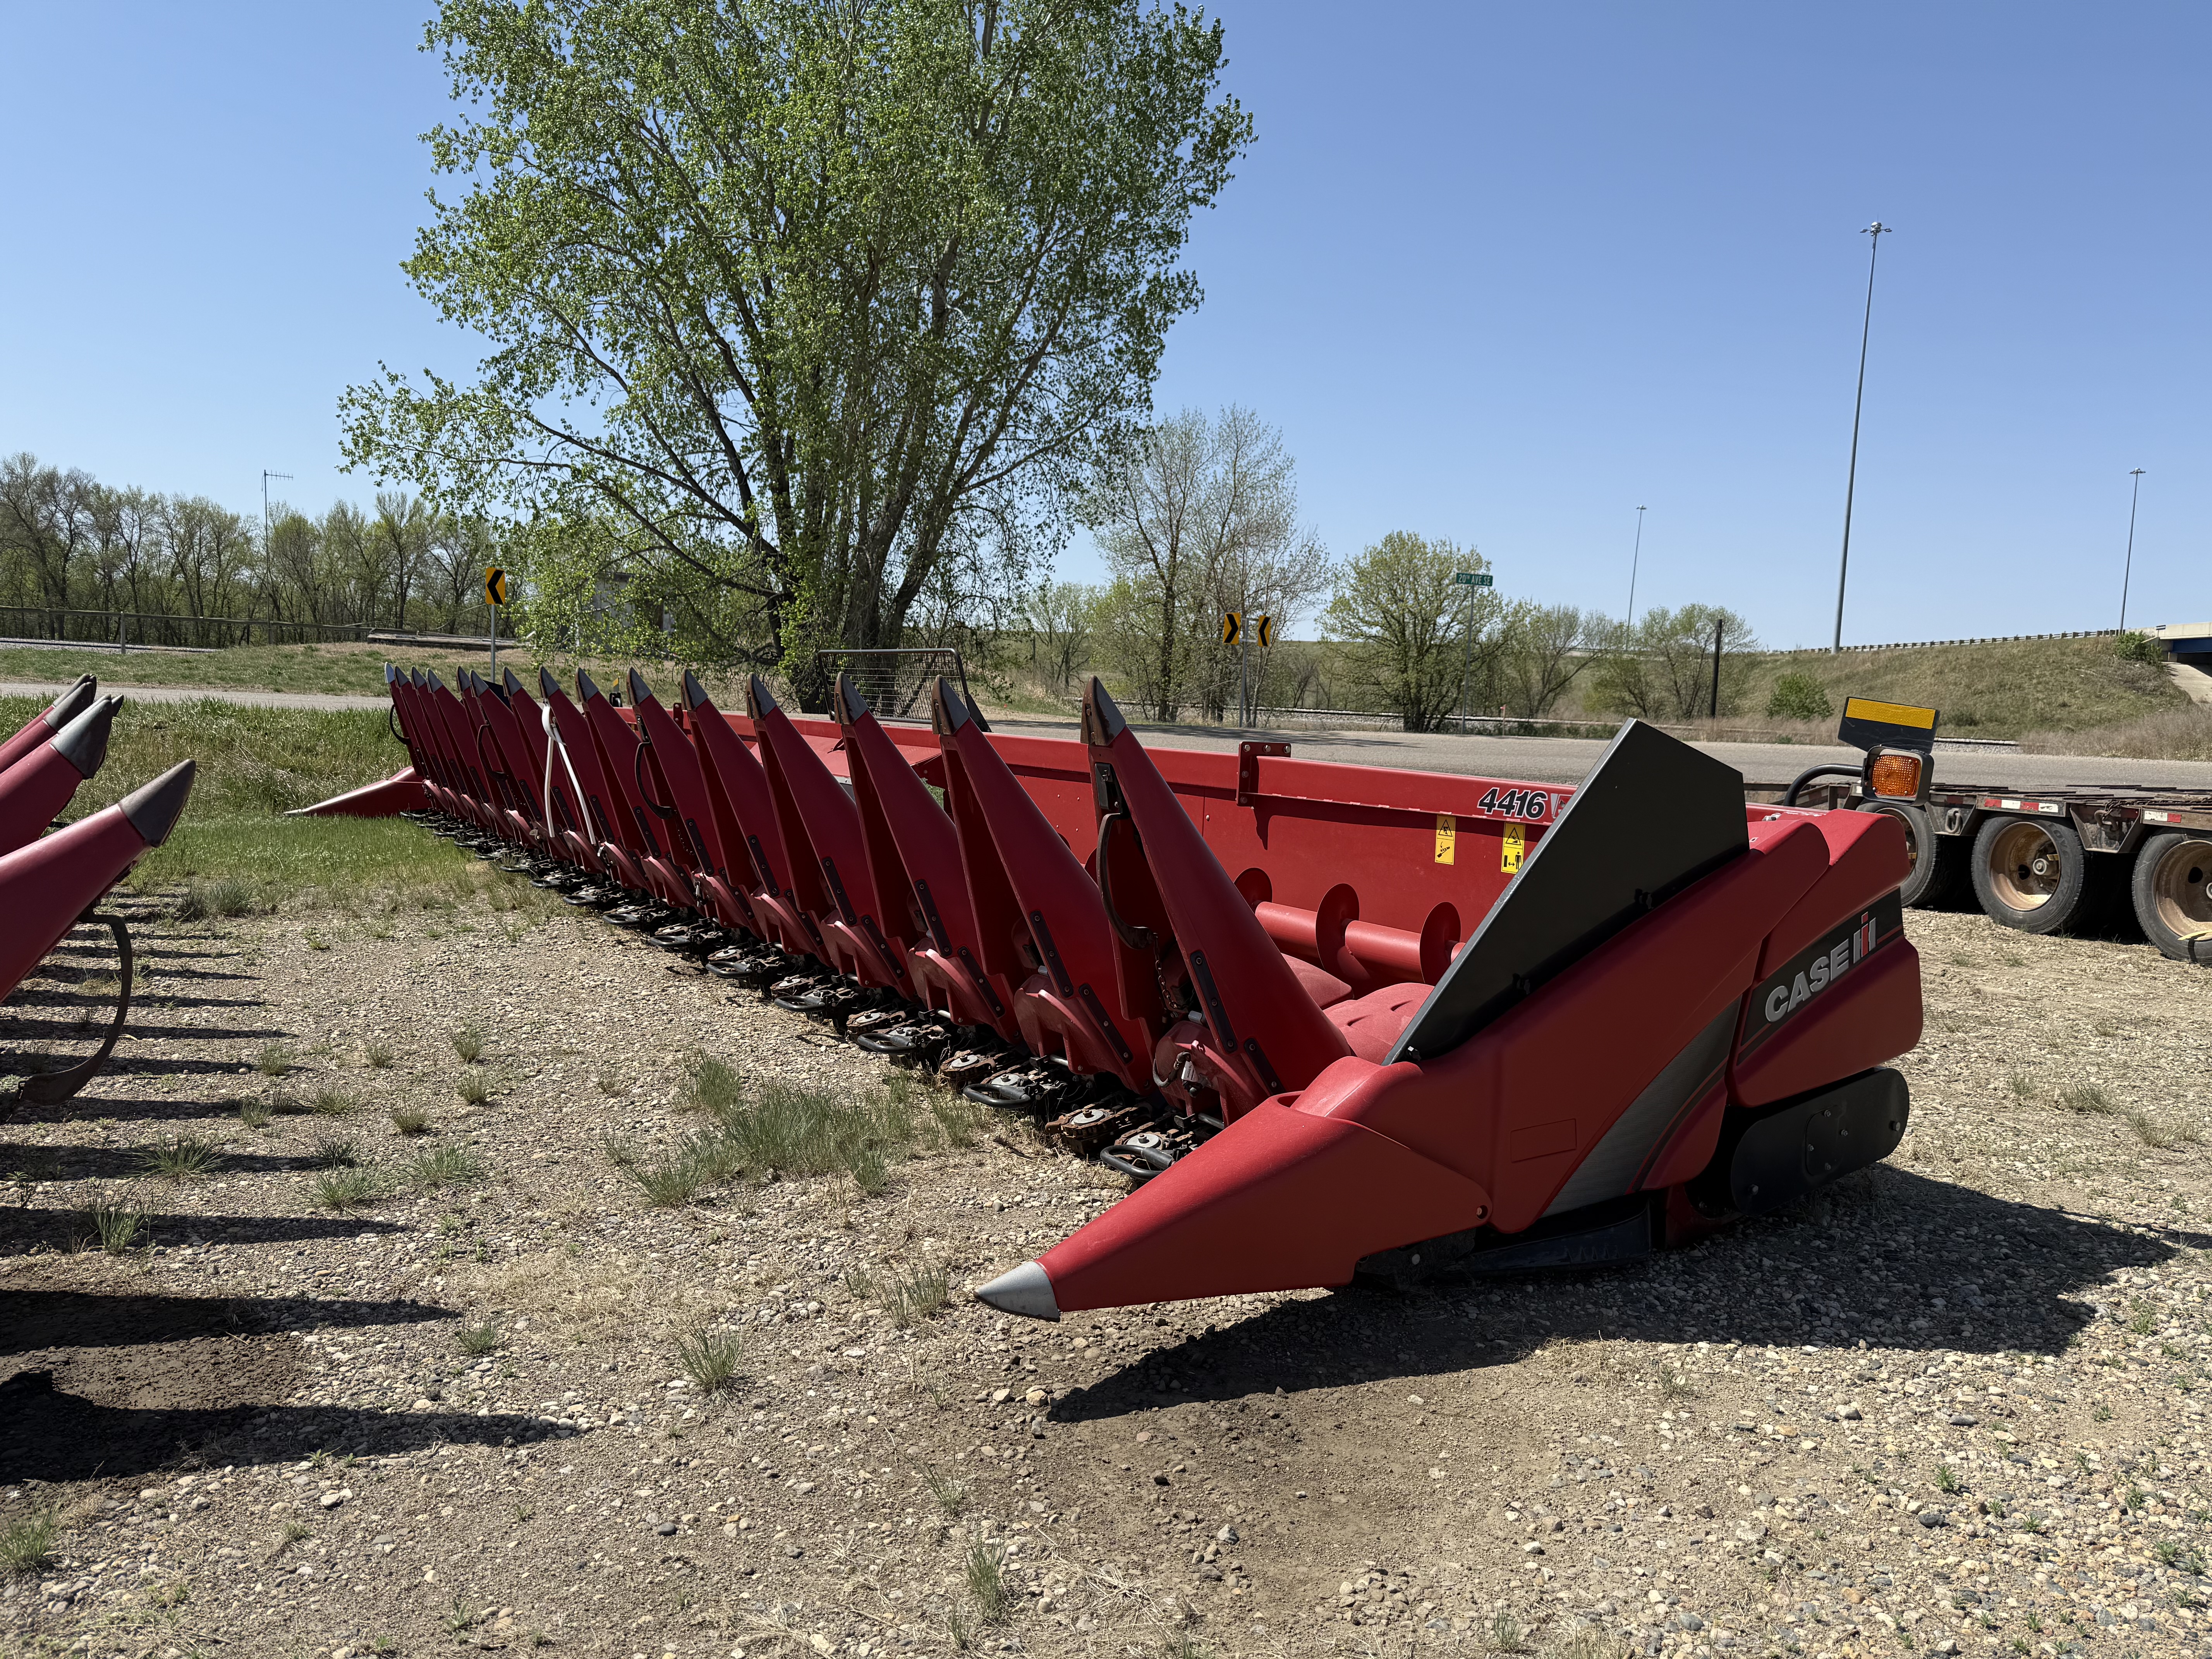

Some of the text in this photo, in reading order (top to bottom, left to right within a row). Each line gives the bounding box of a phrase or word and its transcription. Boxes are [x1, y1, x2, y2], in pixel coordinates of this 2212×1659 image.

[1471, 575, 1482, 584] AVE
[1484, 576, 1491, 585] SE
[1477, 787, 1548, 820] 4416
[1765, 938, 1849, 1022] CASE
